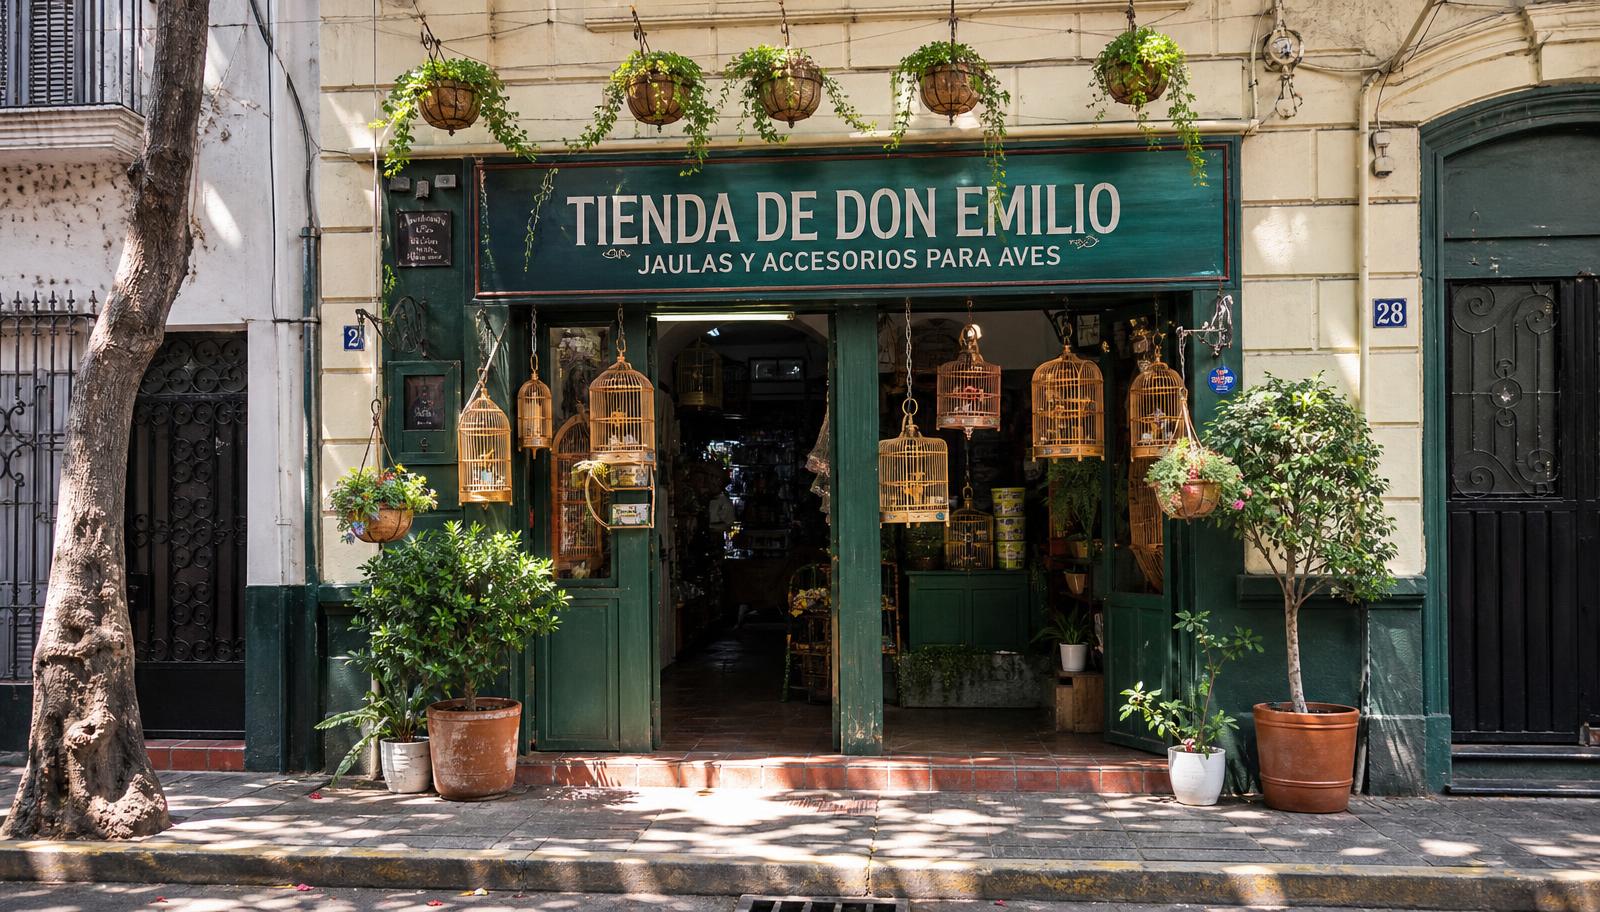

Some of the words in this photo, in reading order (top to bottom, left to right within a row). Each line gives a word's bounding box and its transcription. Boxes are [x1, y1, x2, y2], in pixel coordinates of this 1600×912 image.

[567, 193, 740, 246] TIENDA
[757, 190, 818, 242] DE
[836, 187, 937, 241] DON
[956, 181, 1121, 238] EMILIO
[637, 251, 733, 276] JAULAS
[739, 252, 756, 273] Y
[761, 248, 918, 273] ACCESORIOS
[926, 246, 992, 270] PARA
[998, 244, 1062, 268] AVES
[1376, 302, 1404, 325] 28
